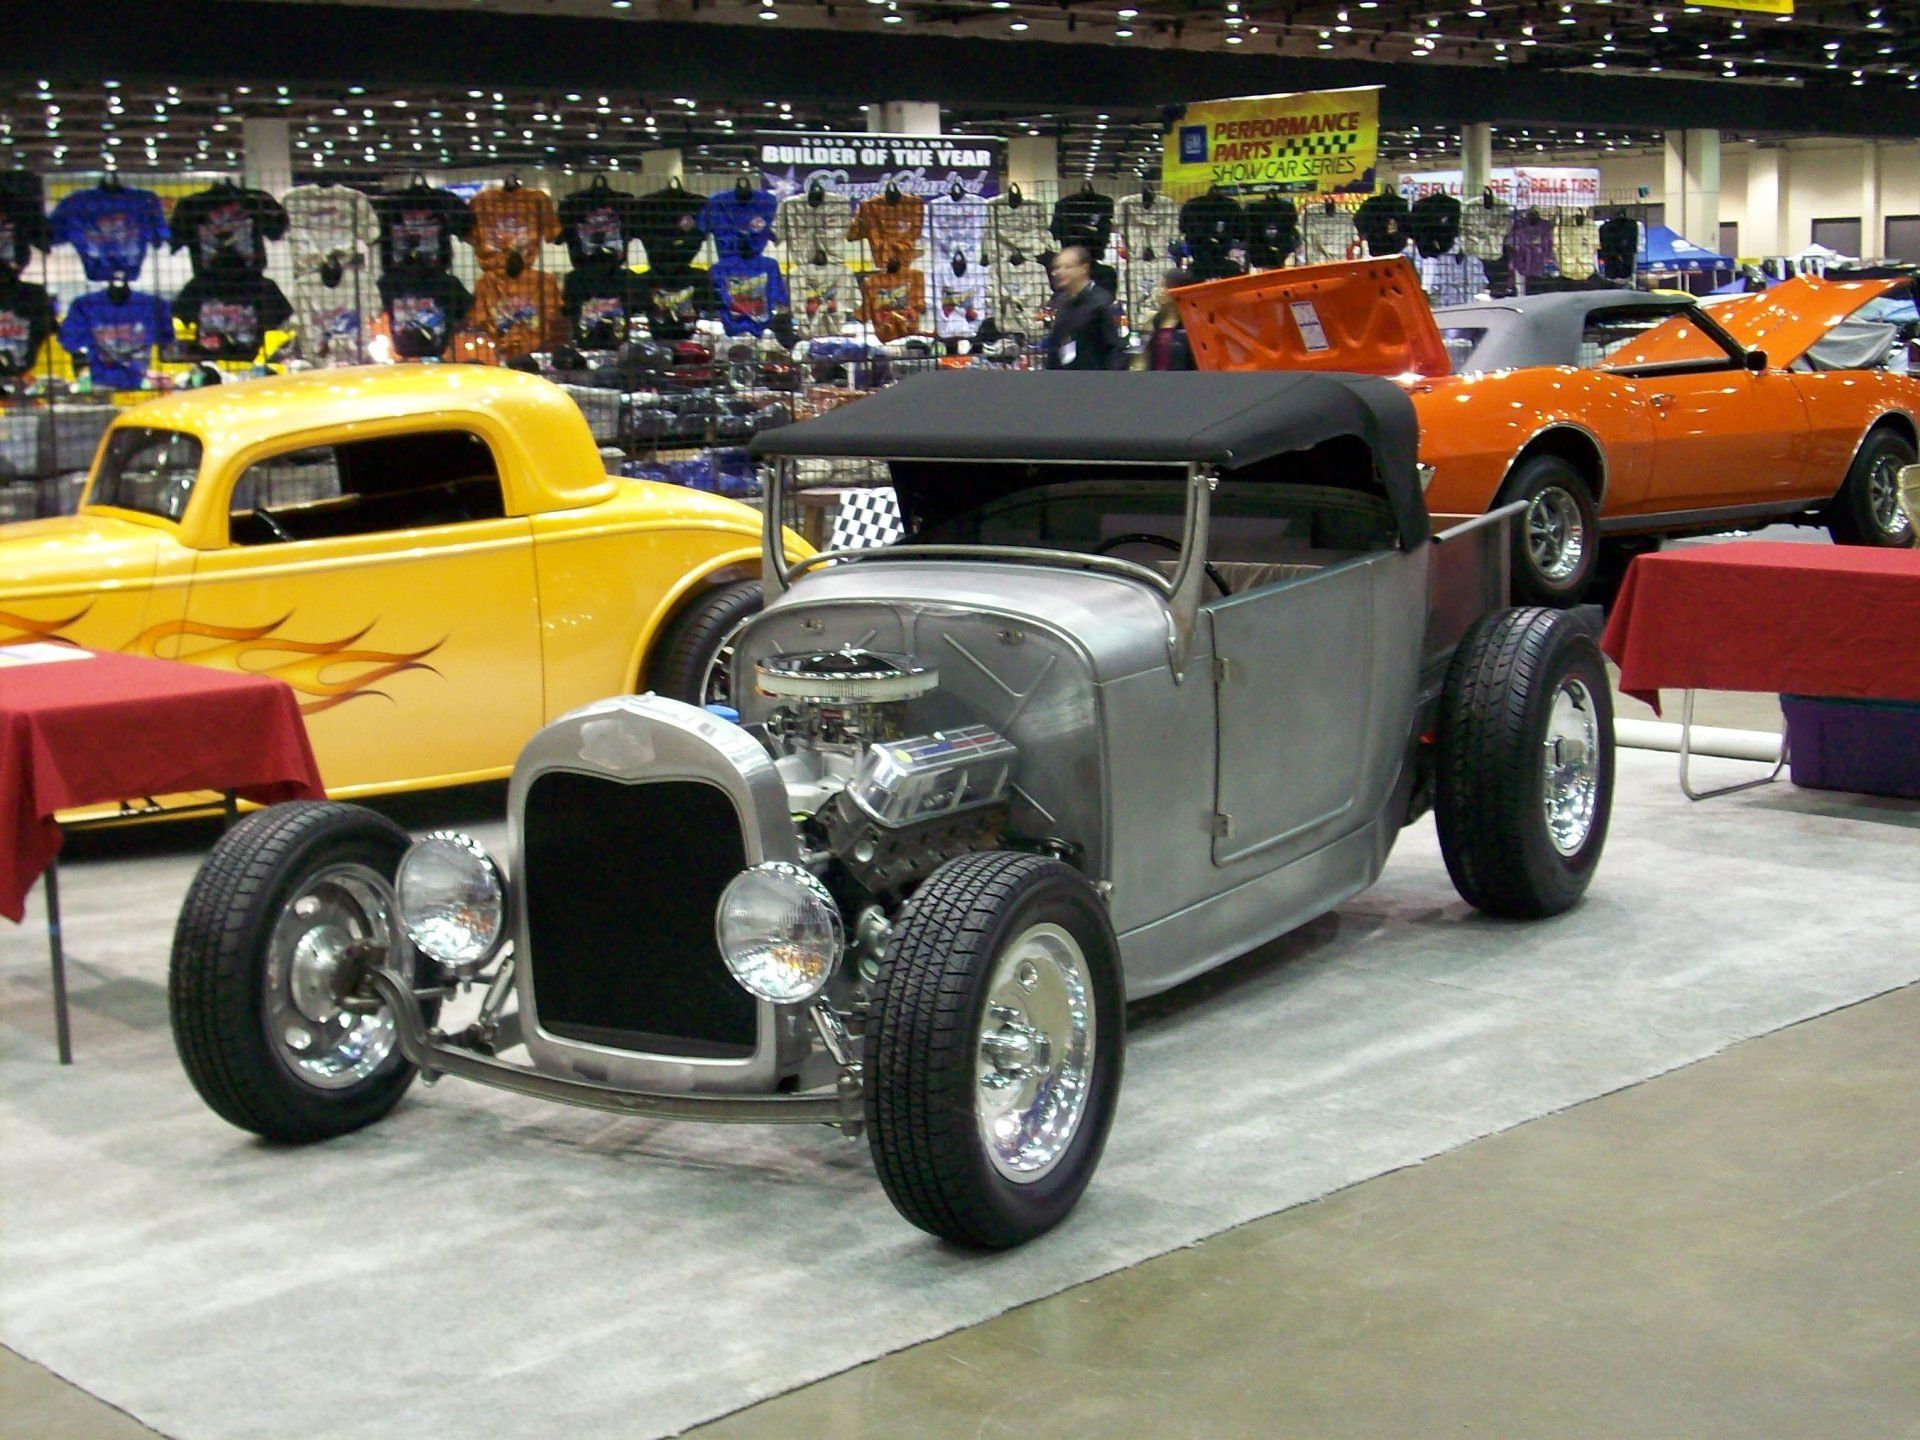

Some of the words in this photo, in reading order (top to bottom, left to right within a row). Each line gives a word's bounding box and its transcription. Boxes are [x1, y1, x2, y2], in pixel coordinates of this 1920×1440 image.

[1213, 112, 1360, 140] PERFORMANCE
[851, 138, 955, 148] AUTORAMA
[1213, 140, 1273, 162] PARTS
[762, 145, 857, 165] BUILDER
[860, 147, 889, 166] OF
[891, 148, 934, 166] THE
[937, 149, 991, 167] YEAR
[1211, 162, 1262, 182] SHOW
[1265, 159, 1298, 179] CAR
[1300, 155, 1356, 176] SERIES
[1531, 177, 1568, 193] BELLE
[1571, 177, 1597, 193] TIRE
